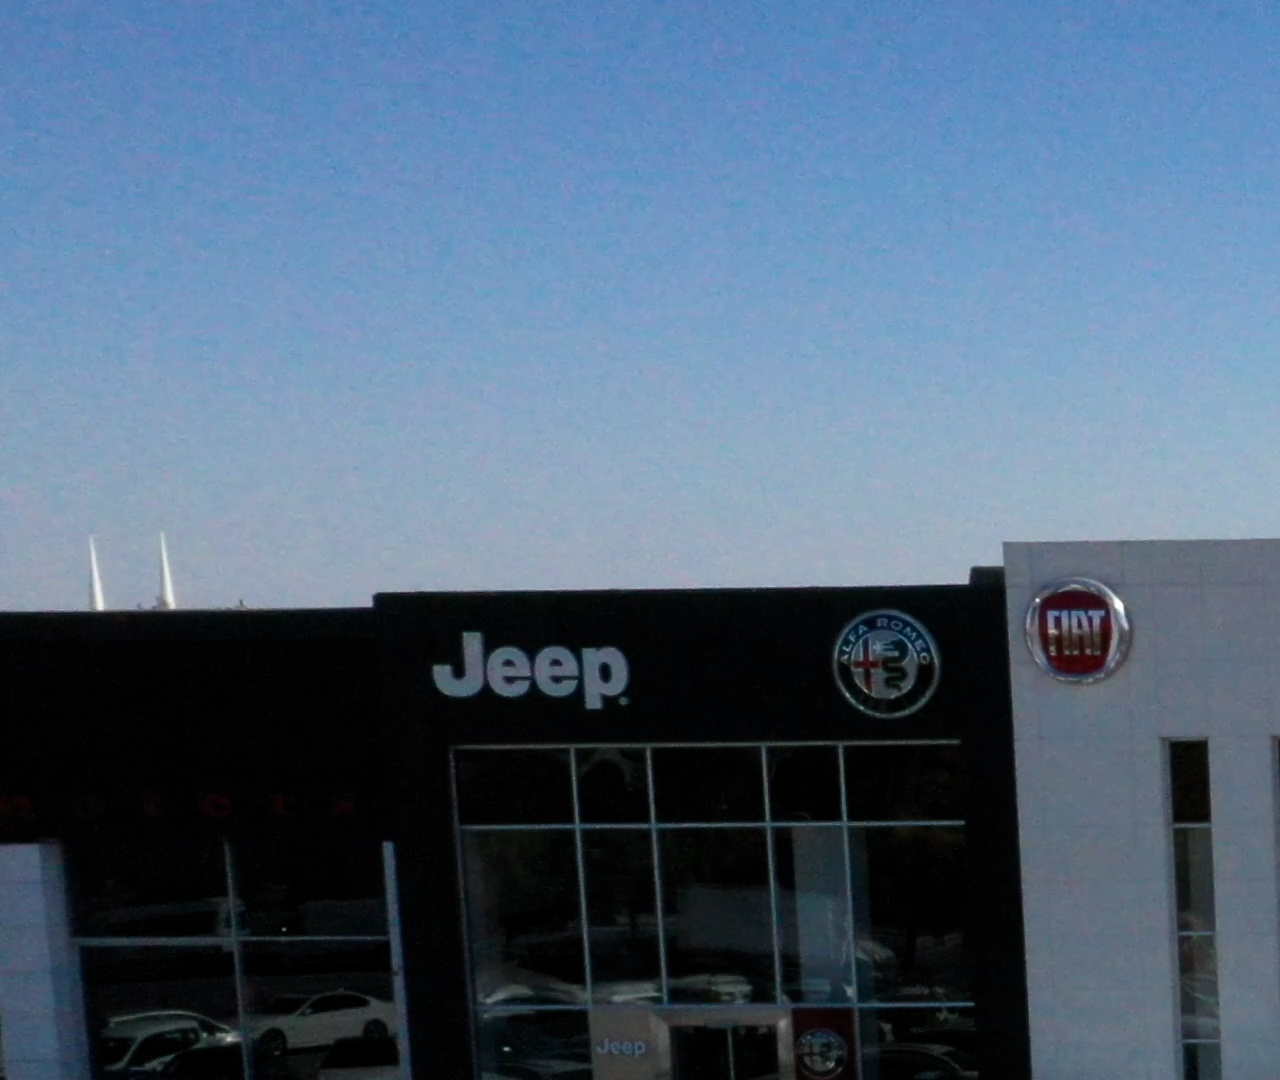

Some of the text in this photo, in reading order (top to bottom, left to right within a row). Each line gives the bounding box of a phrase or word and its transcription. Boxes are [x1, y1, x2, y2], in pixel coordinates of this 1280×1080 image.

[840, 617, 931, 665] ALFA ROMEO
[1046, 609, 1105, 655] FIAT
[432, 631, 628, 709] Jeep
[598, 1039, 646, 1056] Jeep
